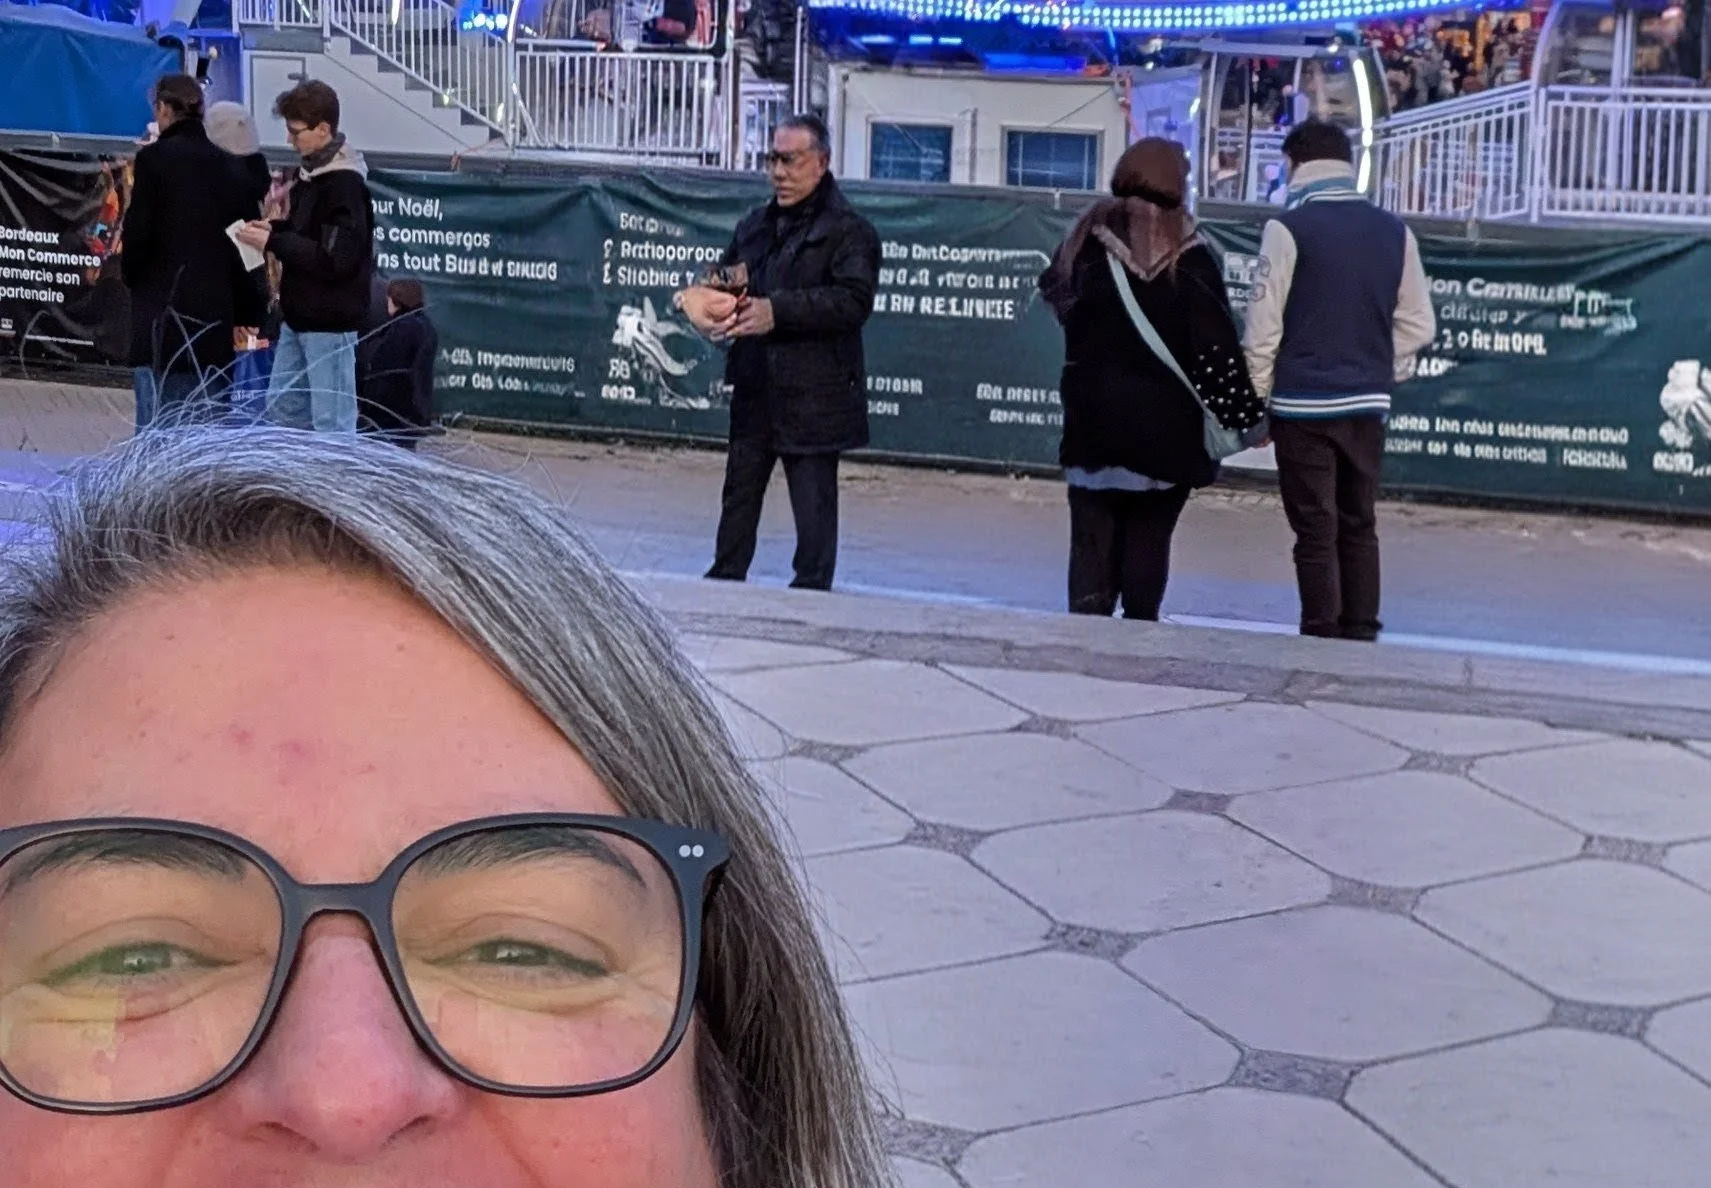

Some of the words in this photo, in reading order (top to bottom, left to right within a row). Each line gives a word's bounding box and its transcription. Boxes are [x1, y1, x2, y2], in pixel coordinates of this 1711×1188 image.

[398, 197, 443, 221] Noël,
[0, 225, 59, 244] Bordeaux
[0, 245, 25, 260] Mon
[27, 248, 101, 267] Commerce
[403, 251, 441, 272] tout
[56, 272, 80, 286] son
